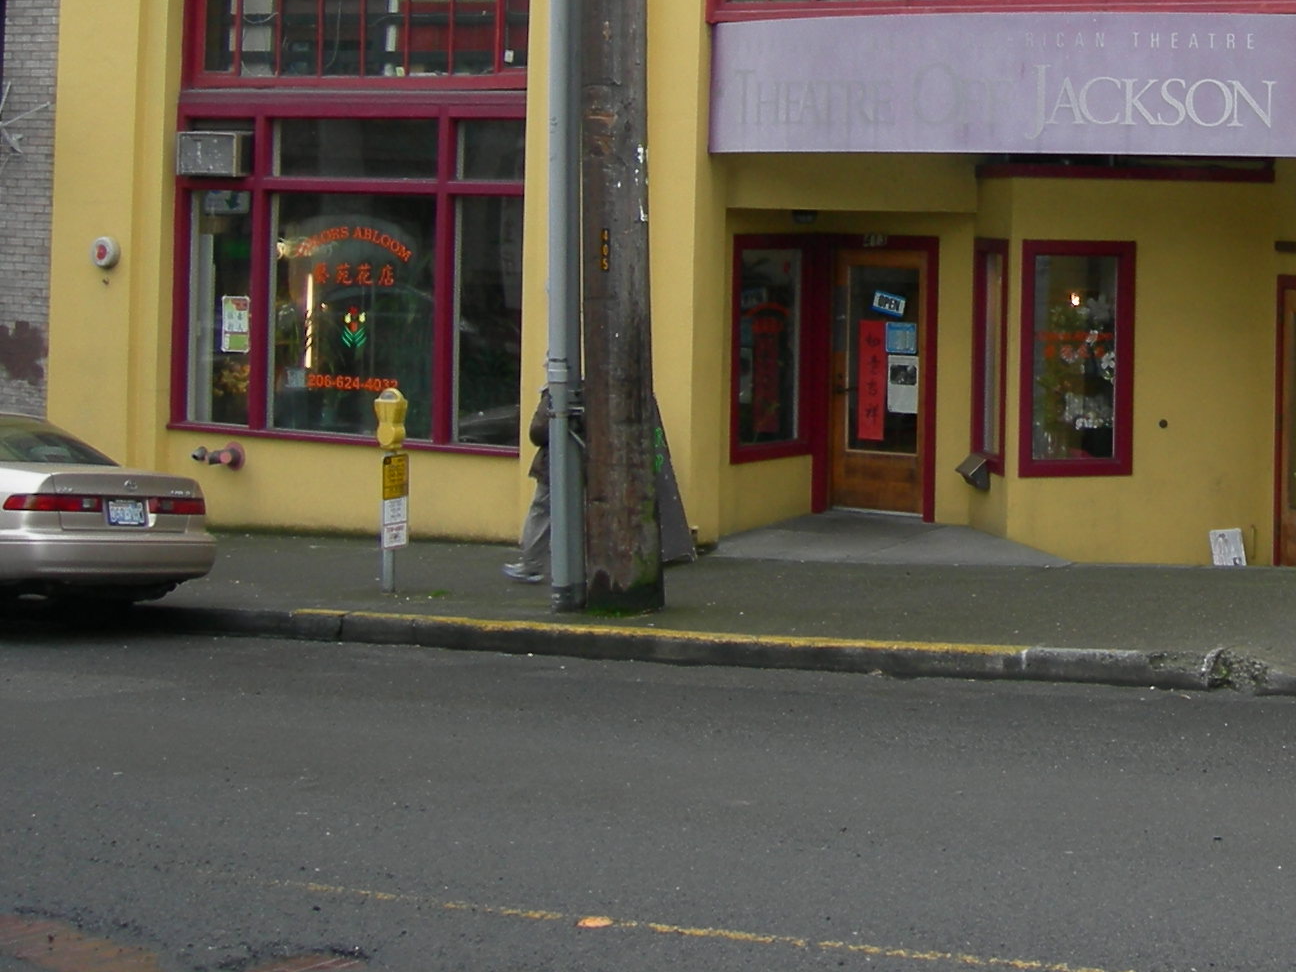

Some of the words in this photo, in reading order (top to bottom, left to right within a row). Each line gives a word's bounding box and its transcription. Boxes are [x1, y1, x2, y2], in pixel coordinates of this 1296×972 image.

[1132, 32, 1256, 50] THEATRE
[735, 69, 896, 127] THEATRE
[1024, 64, 1277, 140] JACKSON
[352, 227, 412, 263] ABLOOM
[878, 294, 900, 312] OPEN
